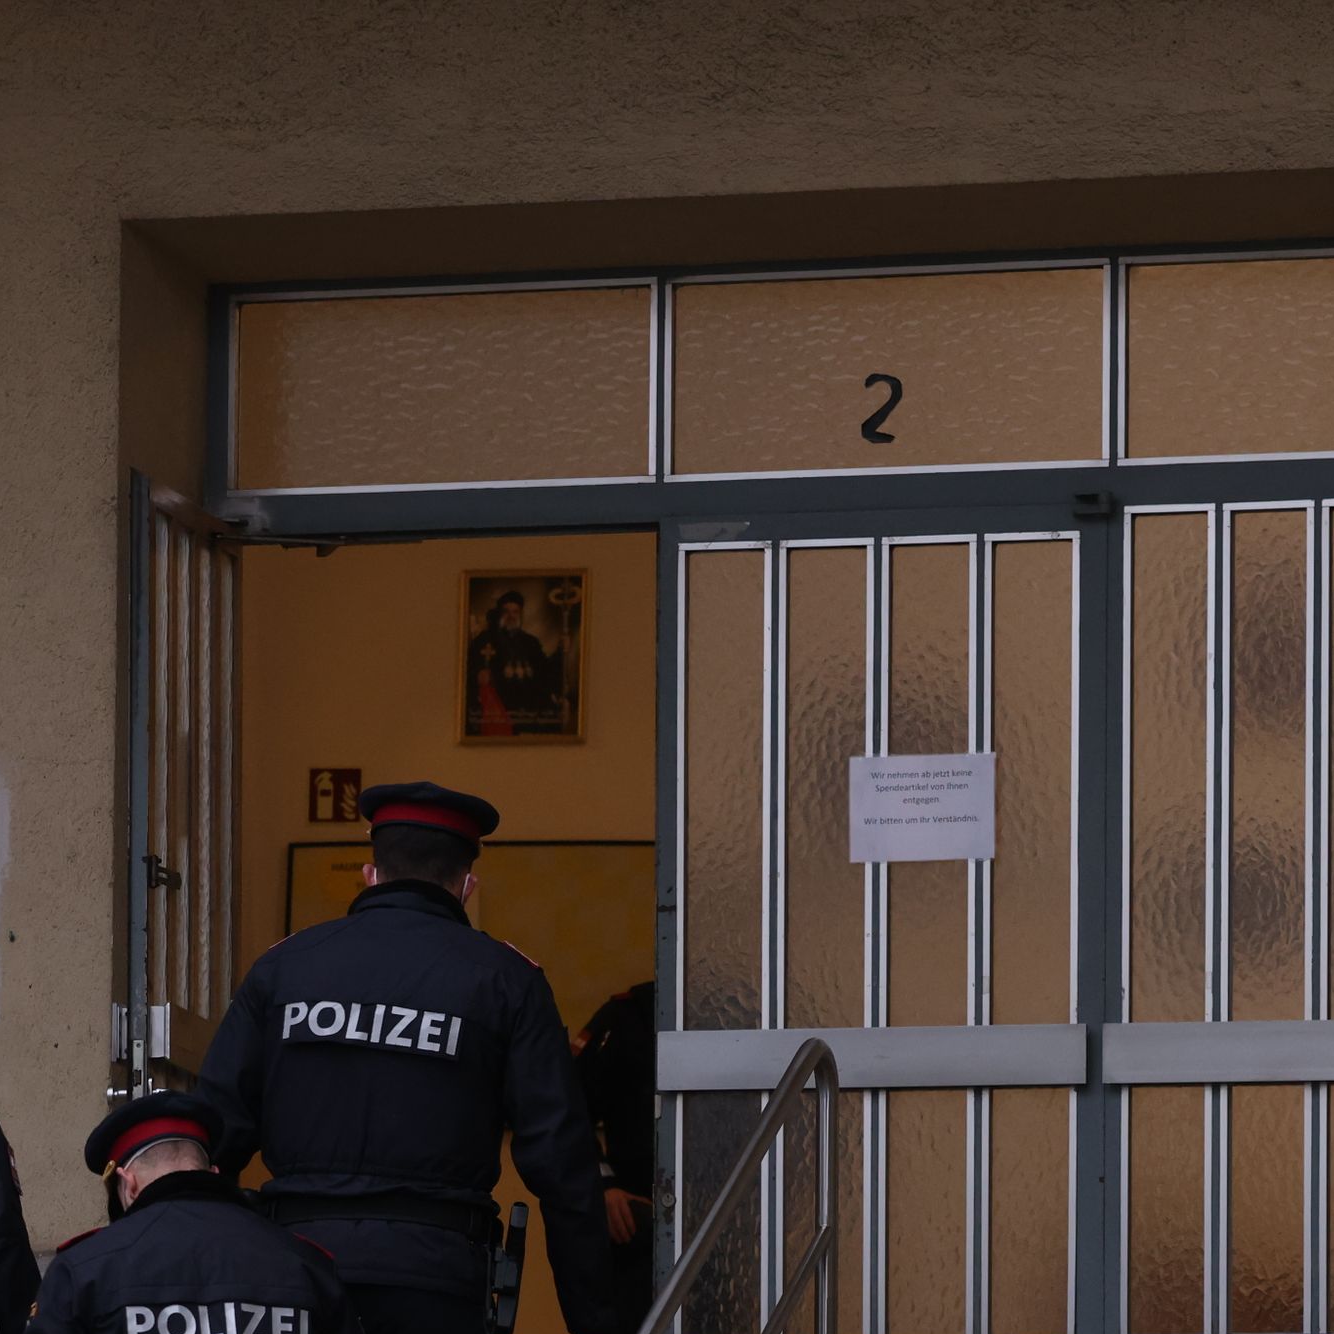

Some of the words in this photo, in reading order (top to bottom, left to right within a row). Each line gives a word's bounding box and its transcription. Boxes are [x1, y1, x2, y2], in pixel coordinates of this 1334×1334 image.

[860, 373, 903, 444] 2
[870, 771, 885, 780] Wir
[886, 771, 920, 780] nehmen
[921, 770, 932, 779] ab
[932, 769, 950, 780] jetzt
[951, 769, 973, 778] keine
[874, 782, 929, 793] Spendeartikel
[930, 783, 945, 791] von
[946, 782, 969, 791] Ihnen
[863, 816, 878, 826] Wir
[879, 816, 904, 826] bitten
[904, 817, 919, 825] um
[919, 816, 931, 825] Ihr
[282, 1001, 462, 1056] POLIZEI
